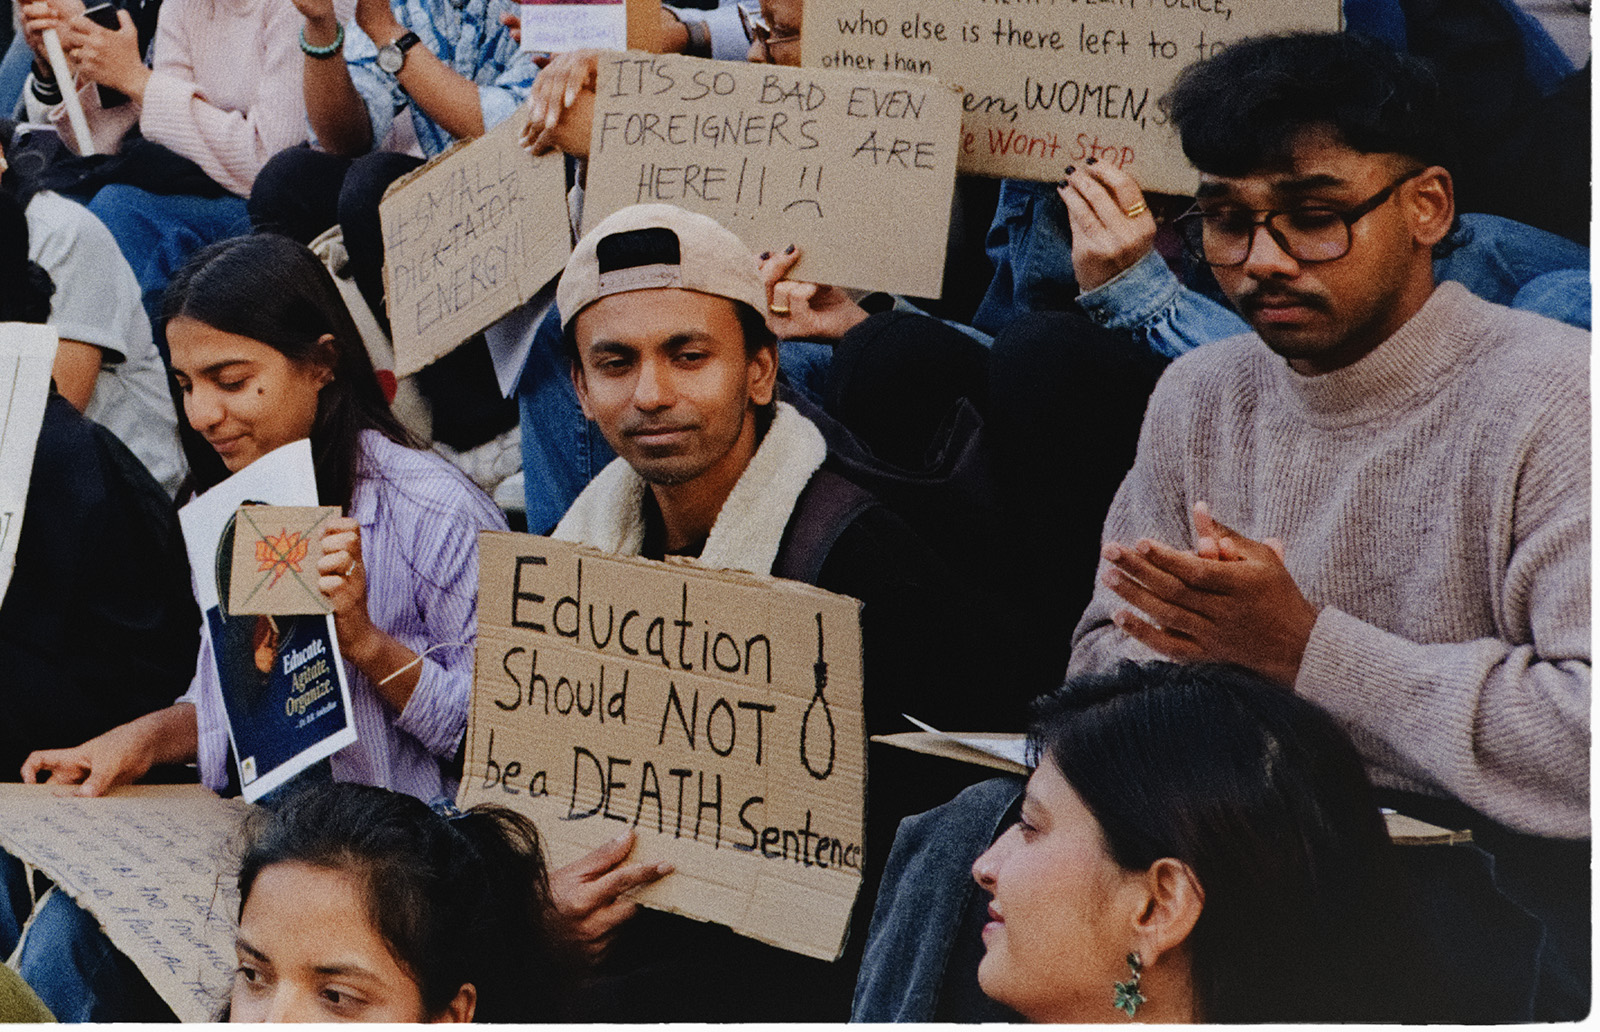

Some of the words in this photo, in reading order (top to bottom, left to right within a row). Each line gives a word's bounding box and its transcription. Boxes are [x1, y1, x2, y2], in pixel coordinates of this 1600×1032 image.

[821, 50, 876, 69] other
[883, 51, 932, 74] than
[837, 9, 889, 38] who
[901, 13, 948, 42] else
[961, 20, 979, 44] is
[993, 17, 1065, 51] there
[1079, 21, 1130, 56] left
[1148, 30, 1178, 59] to
[610, 59, 675, 98] IT'S
[681, 71, 736, 101] SO
[758, 75, 826, 111] BAD
[847, 87, 926, 119] EVEN
[1024, 77, 1150, 130] WOMEN,
[600, 111, 819, 153] FOREIGNERS
[852, 130, 936, 169] ARE
[988, 128, 1062, 159] Won't
[635, 157, 766, 220] HERE!!
[511, 555, 772, 684] Education
[282, 638, 326, 675] Educate,
[494, 647, 629, 725] Should
[658, 681, 776, 765] NOT
[482, 728, 522, 795] be
[528, 773, 549, 798] a
[558, 746, 724, 848] DEATH
[733, 797, 862, 869] Sentence
